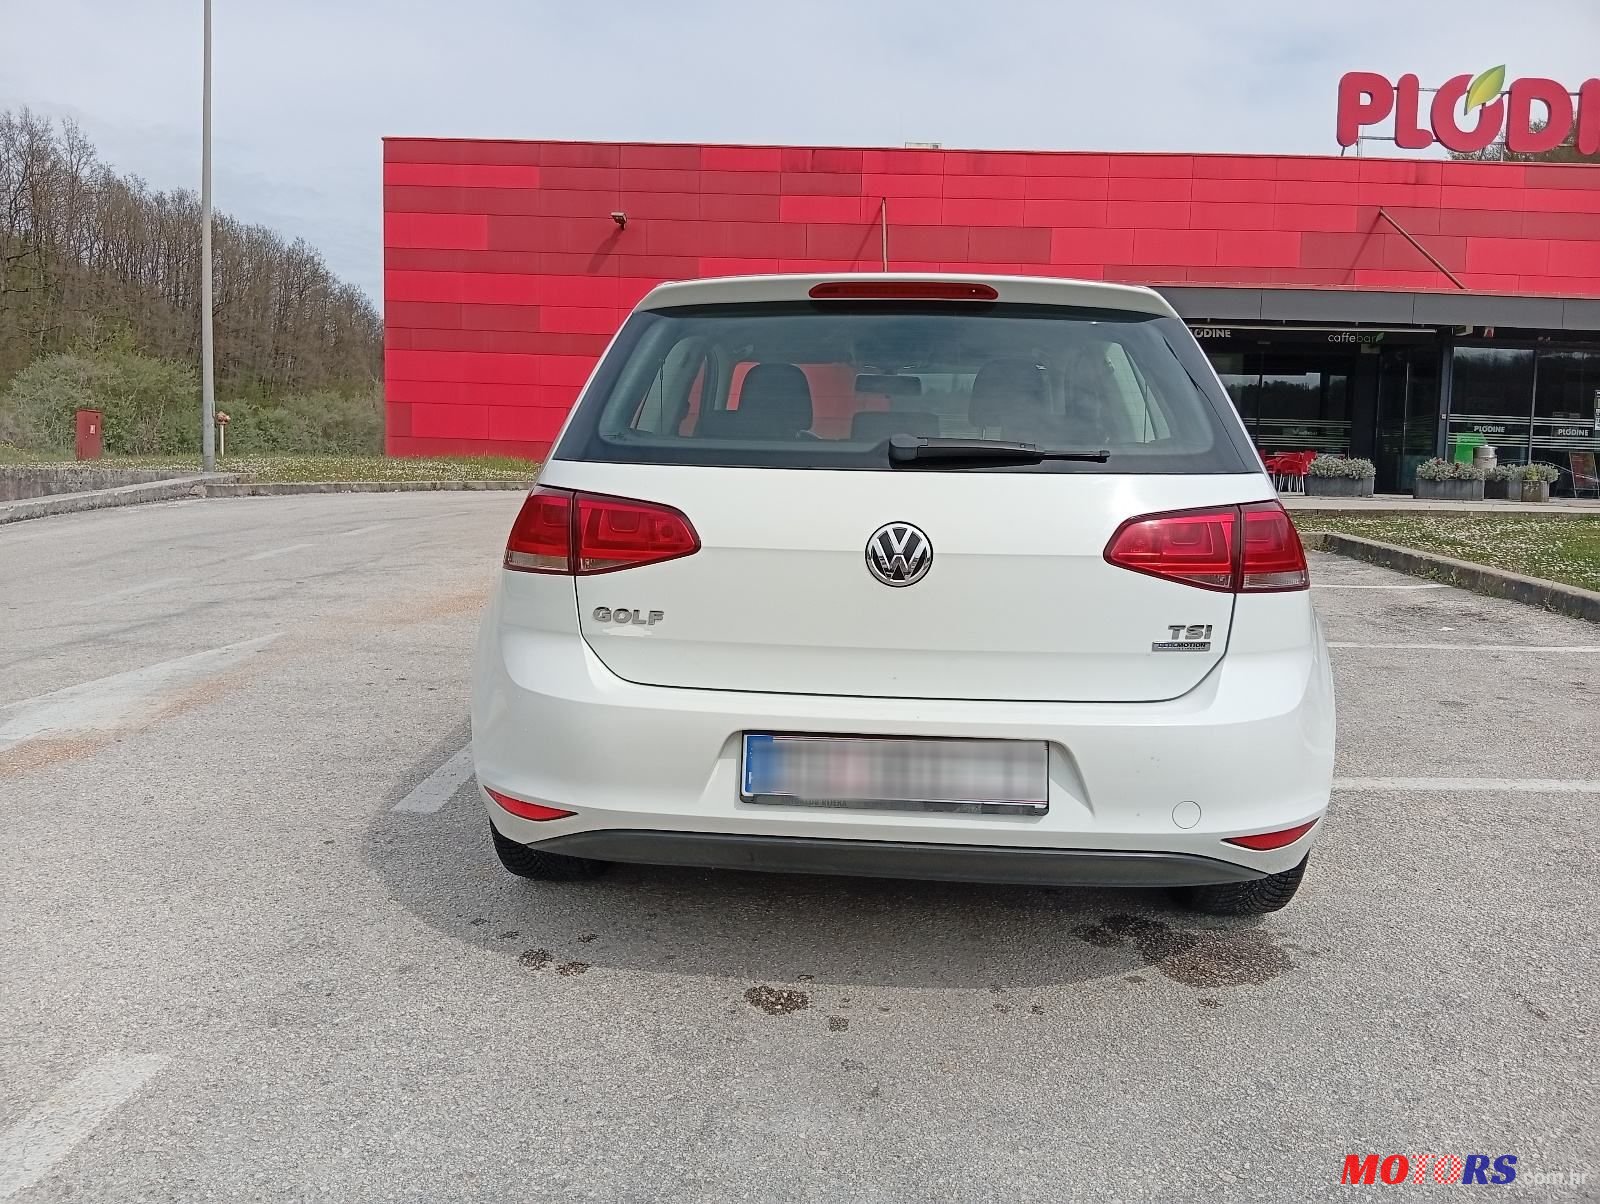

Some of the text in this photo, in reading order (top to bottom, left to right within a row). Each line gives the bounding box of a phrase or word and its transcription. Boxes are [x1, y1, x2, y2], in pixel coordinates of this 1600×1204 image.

[1190, 328, 1231, 338] ODINE
[1328, 332, 1377, 343] caffebar
[1474, 425, 1505, 433] PLODINE
[1558, 428, 1588, 437] PLODINE
[592, 606, 664, 625] GOLF
[1168, 624, 1212, 640] TSI
